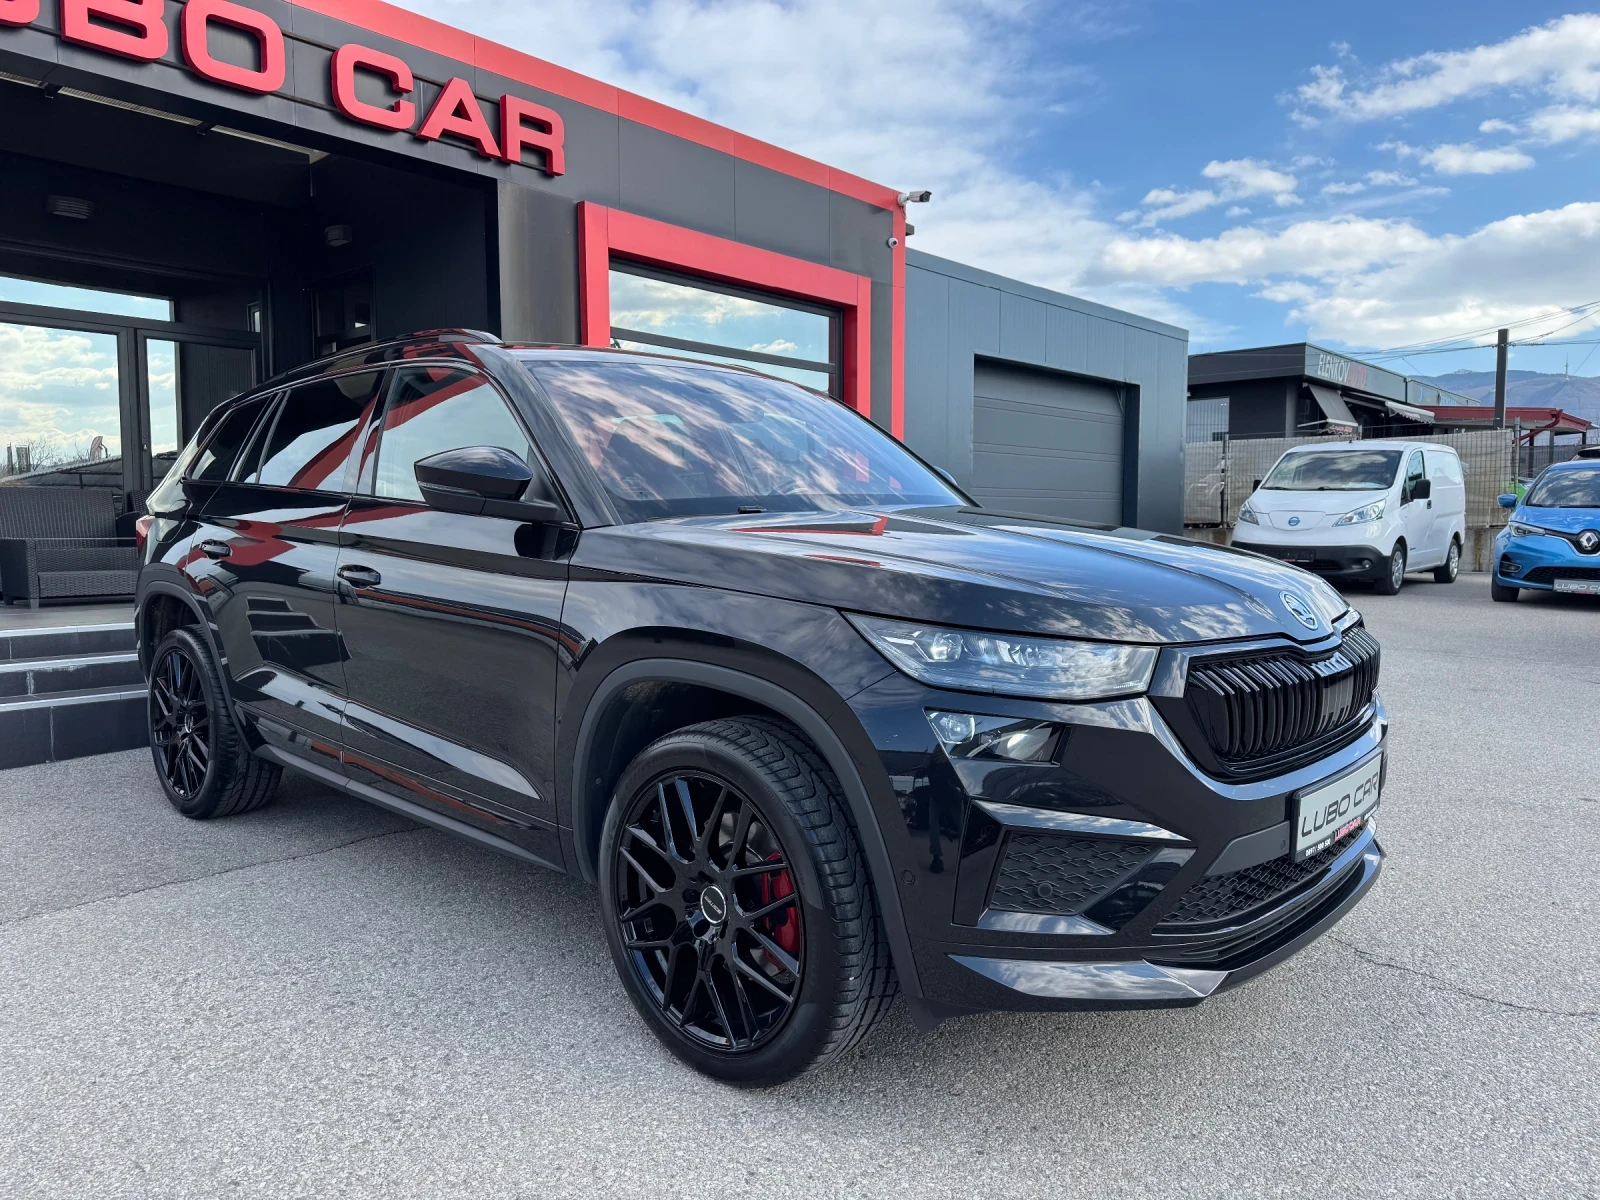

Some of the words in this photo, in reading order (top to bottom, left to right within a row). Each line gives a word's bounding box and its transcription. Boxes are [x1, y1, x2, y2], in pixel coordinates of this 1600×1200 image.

[0, 0, 286, 94] BO
[330, 43, 565, 176] CAR
[1302, 794, 1351, 837] LUBO
[1354, 772, 1378, 807] CAR
